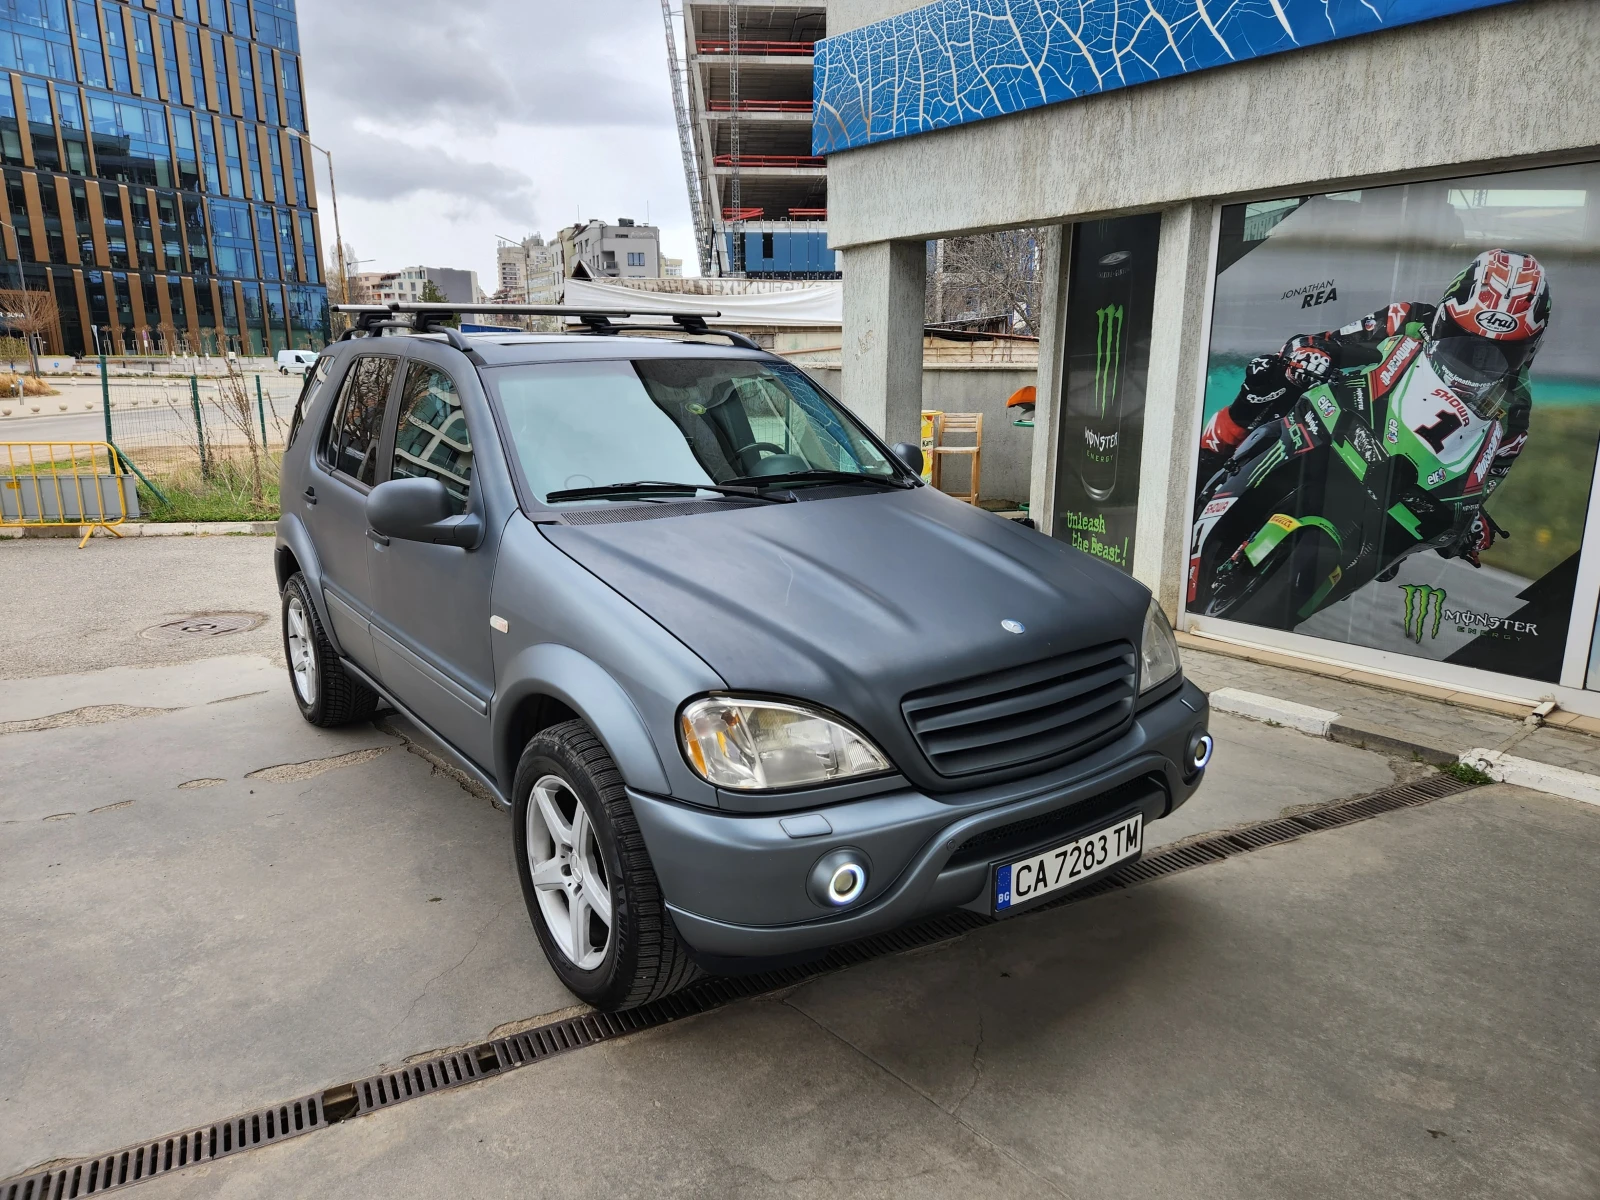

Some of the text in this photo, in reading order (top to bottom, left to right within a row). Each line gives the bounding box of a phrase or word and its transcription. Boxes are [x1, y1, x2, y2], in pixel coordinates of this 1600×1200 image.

[1281, 279, 1334, 300] JONATHAN
[1301, 288, 1337, 309] REA
[1486, 312, 1514, 329] Arai
[1431, 388, 1470, 427] SHOWA
[1304, 411, 1319, 435] Ninja
[1388, 418, 1399, 435] elf
[1413, 409, 1463, 455] 1
[1084, 426, 1119, 452] MONSTER
[1086, 449, 1114, 463] ENERGY
[1066, 510, 1106, 535] Unleash
[1072, 530, 1130, 567] the Beast!
[1444, 609, 1538, 636] MONSTER
[1456, 625, 1523, 643] ENERGY
[1015, 819, 1139, 897] CA 7283 TM
[998, 891, 1010, 904] BG
